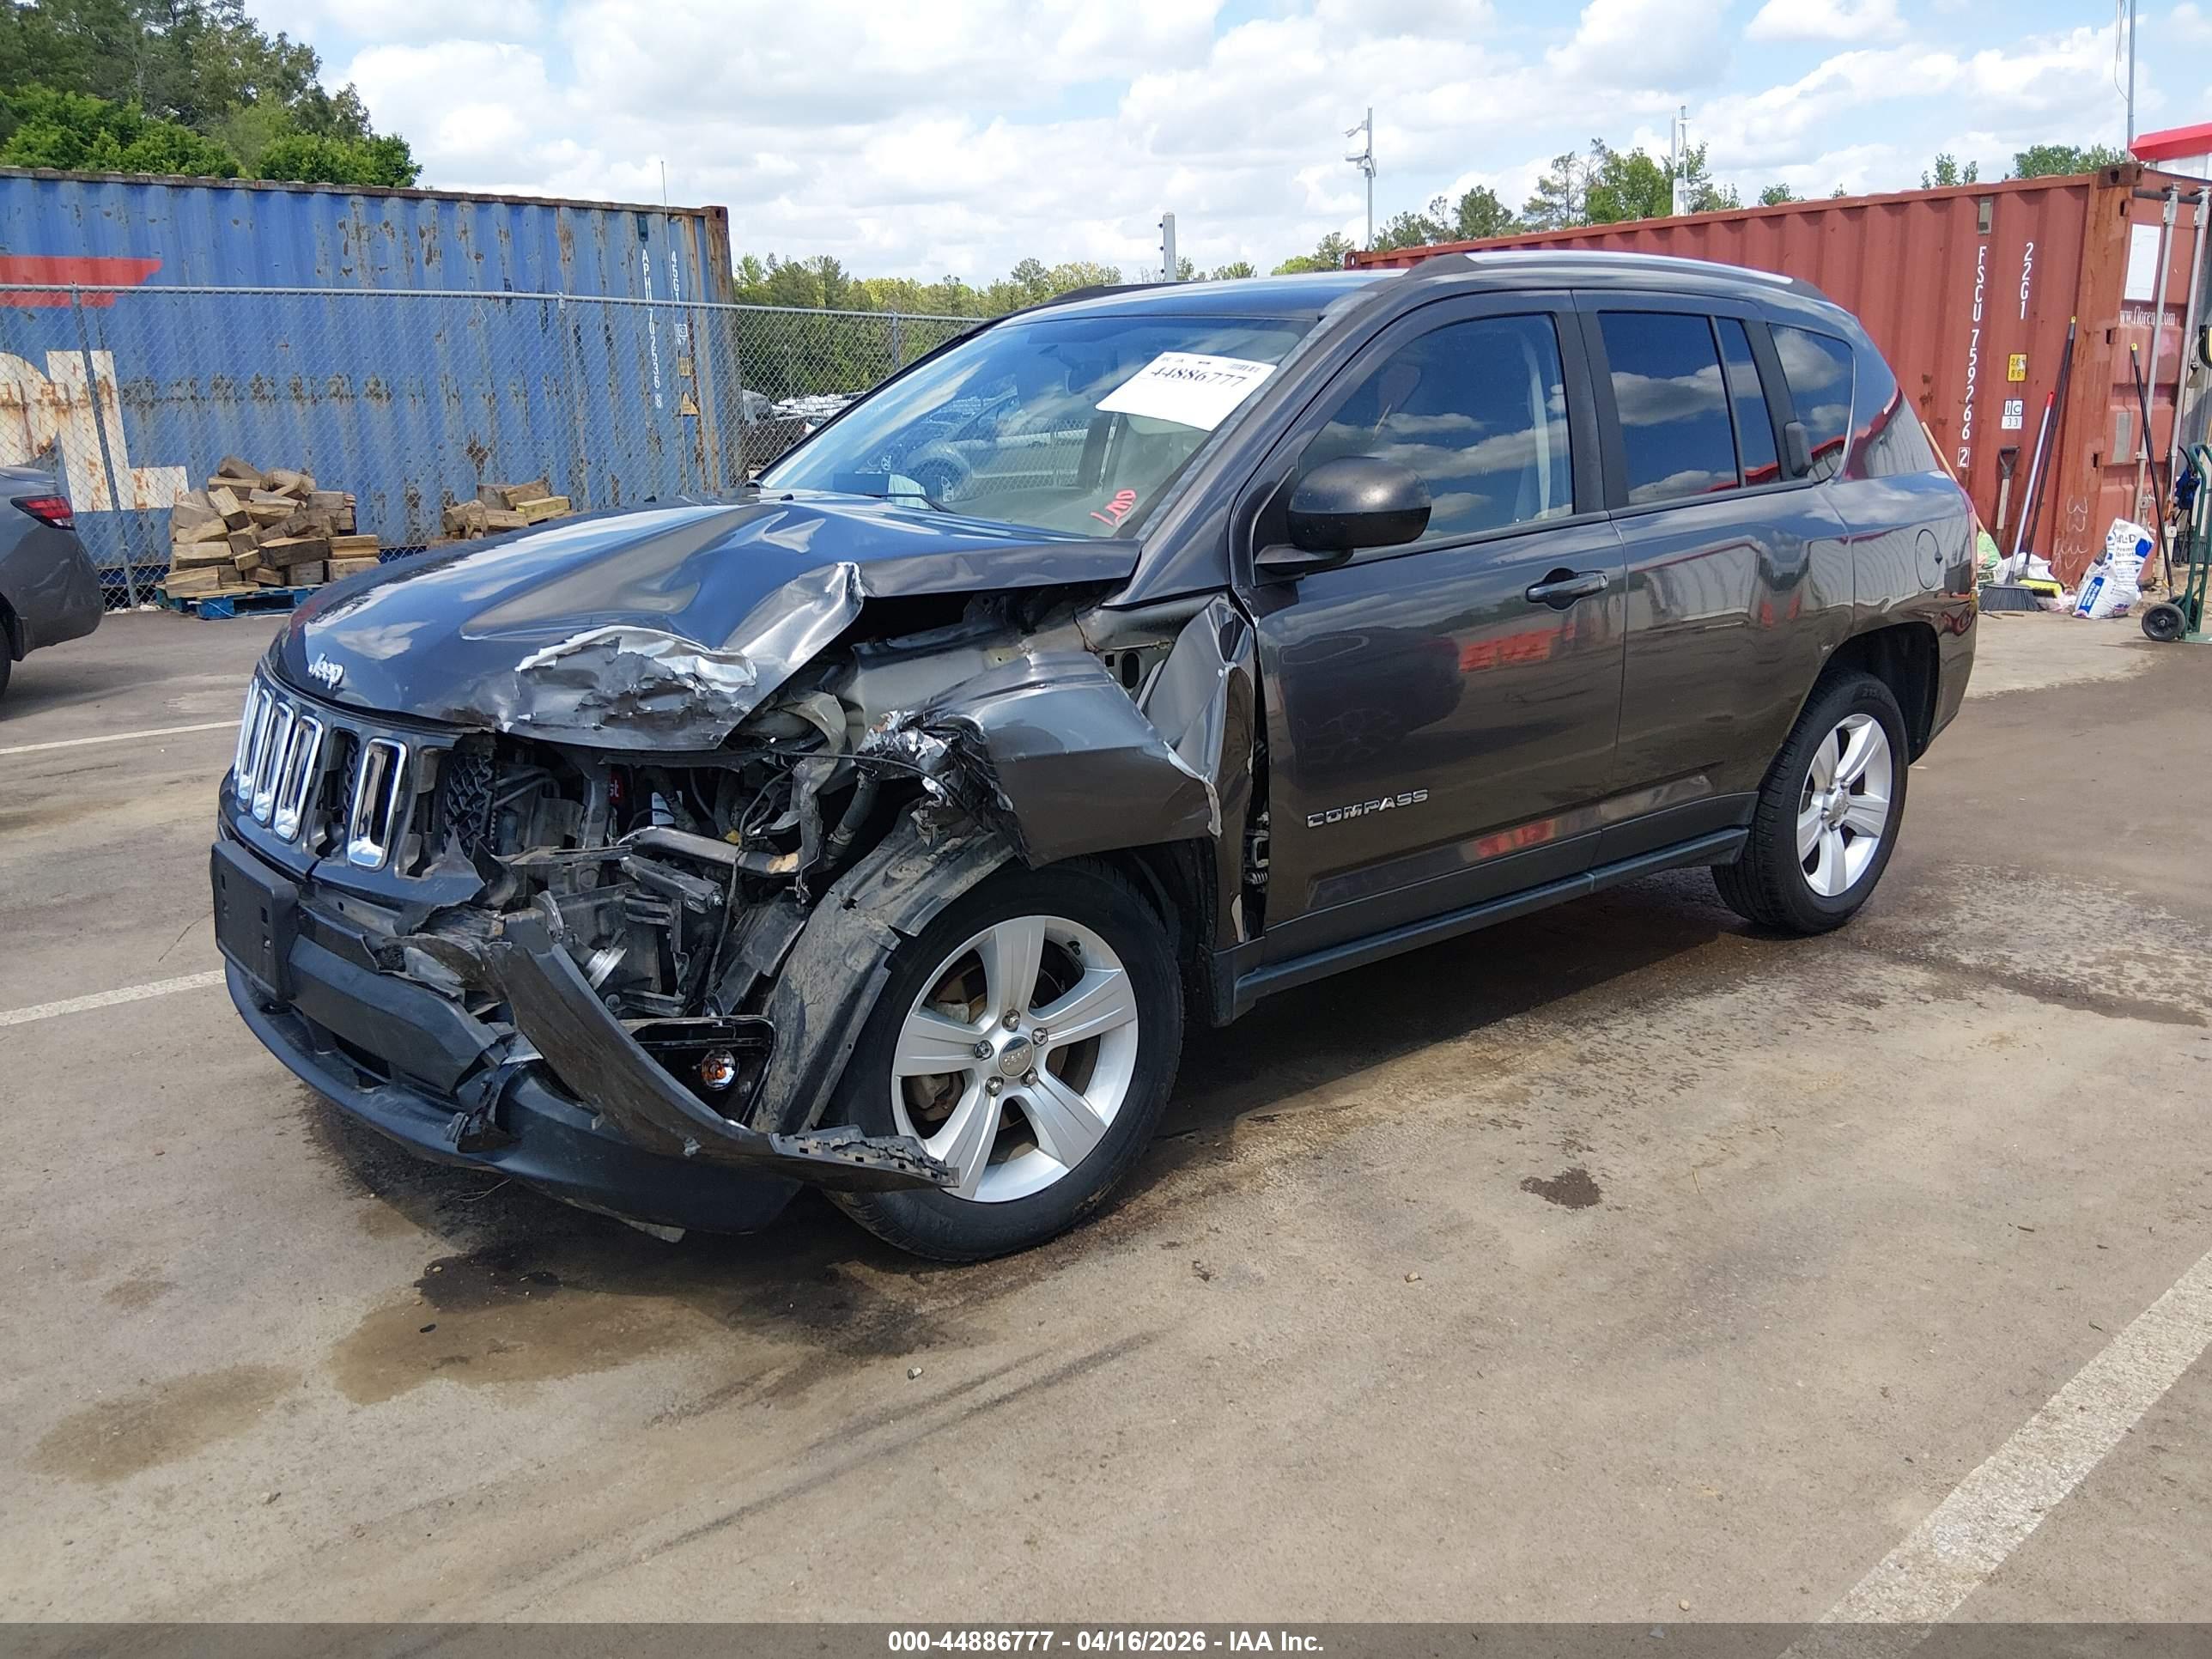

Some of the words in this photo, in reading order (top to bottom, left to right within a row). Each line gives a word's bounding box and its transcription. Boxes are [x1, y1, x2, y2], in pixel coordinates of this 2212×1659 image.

[1972, 246, 1988, 322] FSCU
[2020, 241, 2034, 320] 22G1
[1151, 366, 1249, 387] 44886777
[1961, 329, 1980, 441] 759266
[308, 653, 343, 690] Jeep
[1307, 788, 1429, 829] COMPASS
